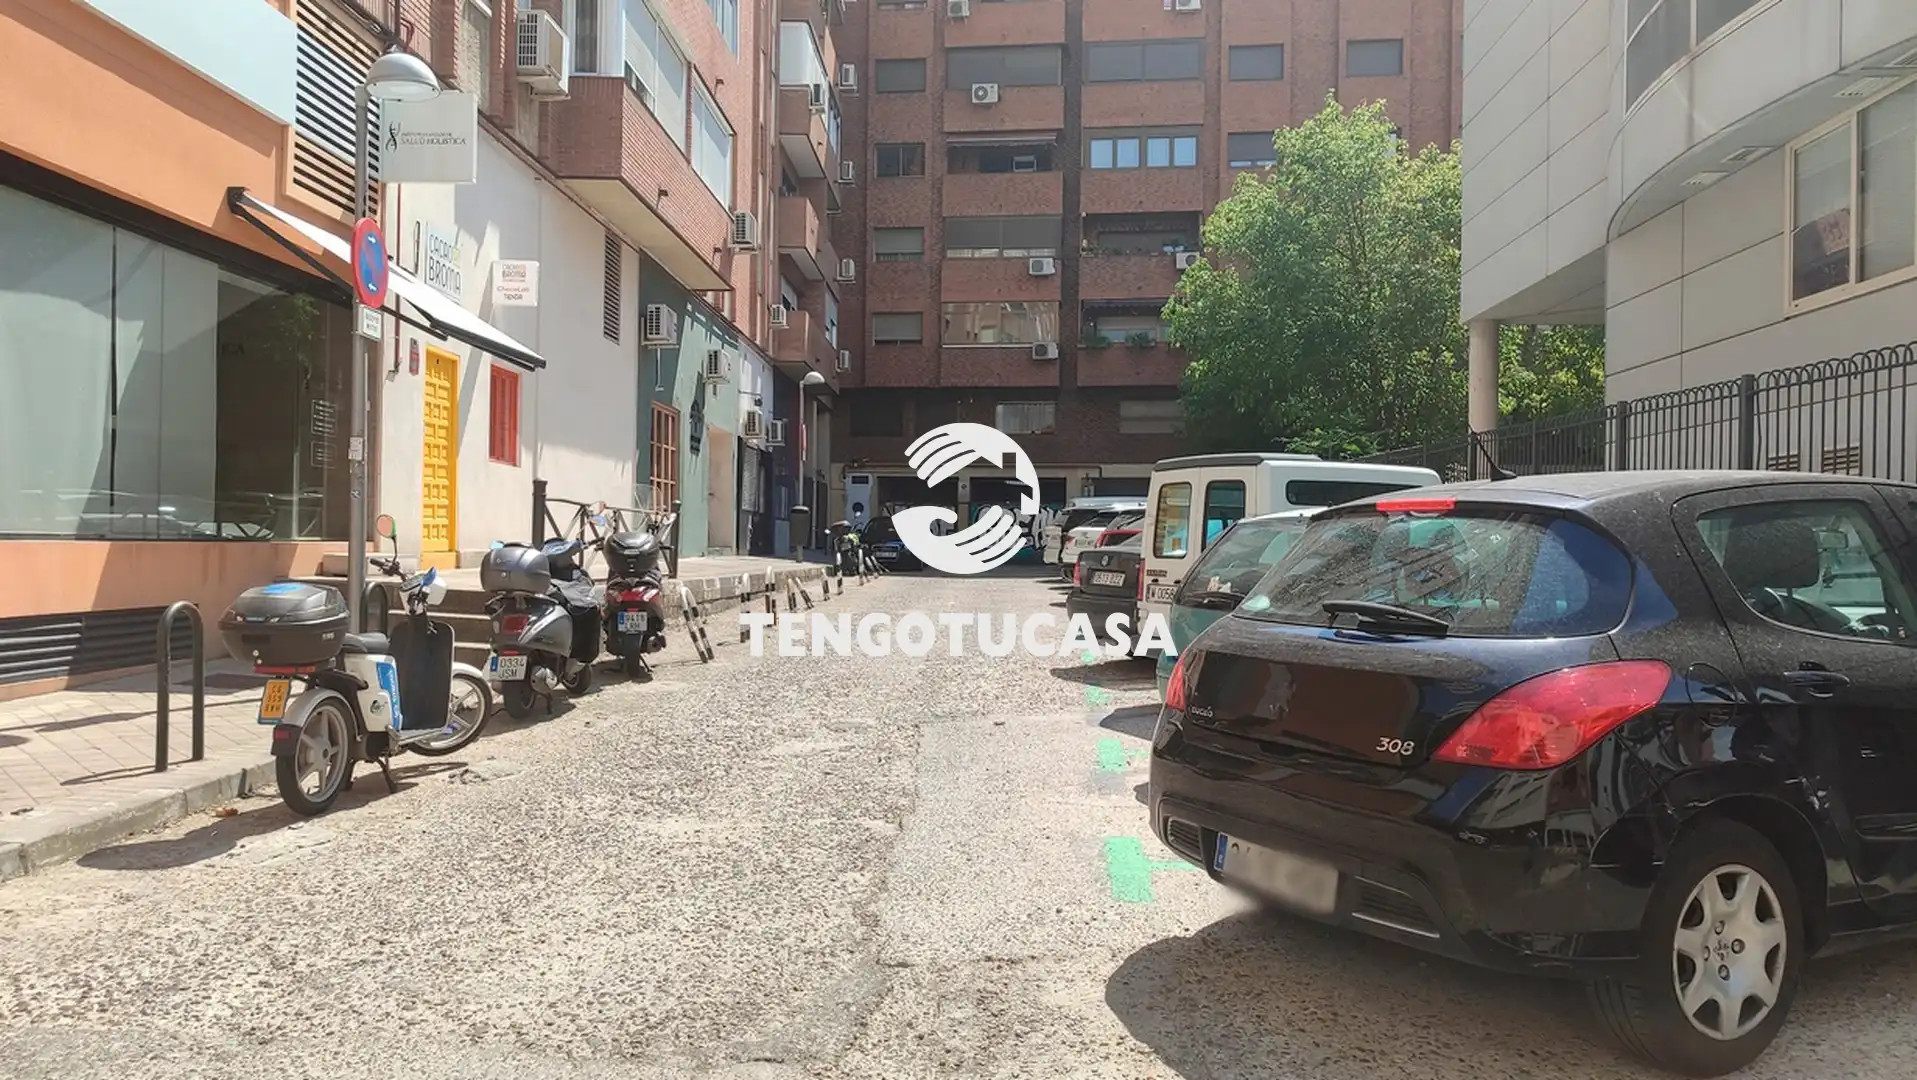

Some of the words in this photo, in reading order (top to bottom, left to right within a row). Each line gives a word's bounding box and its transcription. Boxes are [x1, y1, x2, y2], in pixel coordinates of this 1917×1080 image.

[428, 255, 461, 297] BROMA
[500, 656, 525, 669] 0334
[1375, 736, 1416, 756] 308
